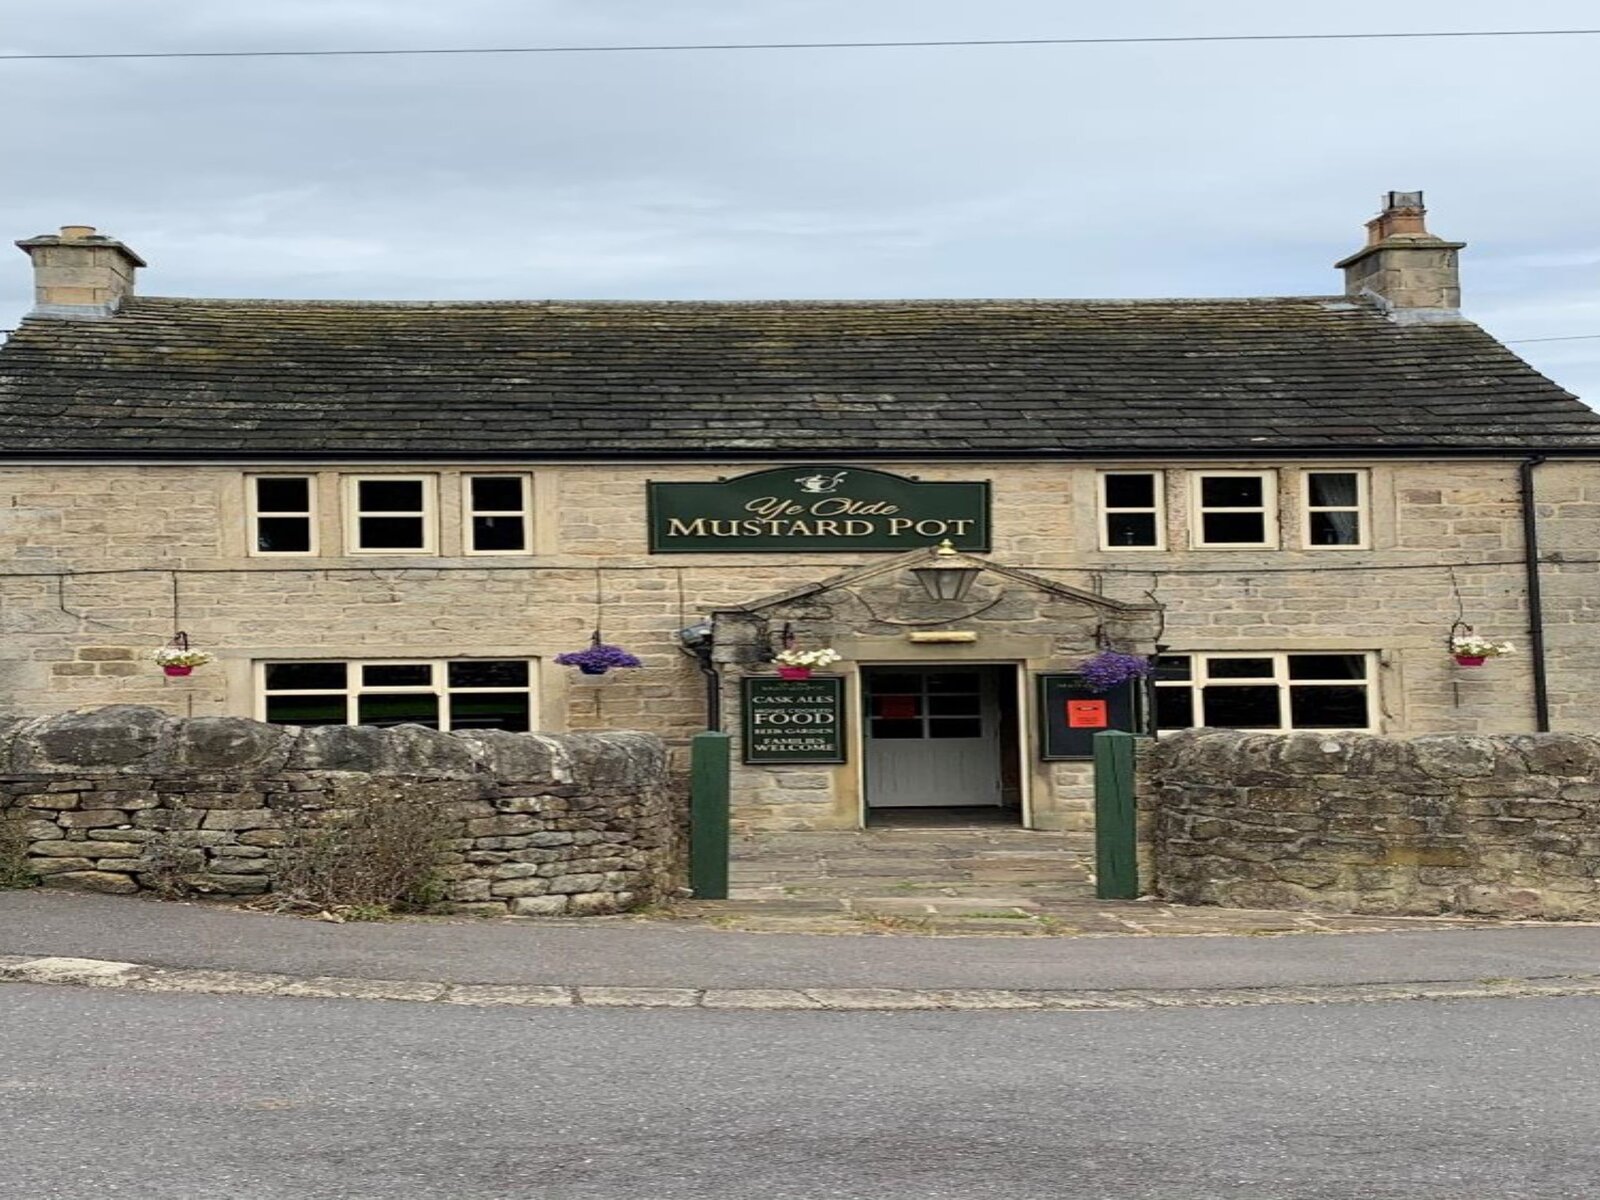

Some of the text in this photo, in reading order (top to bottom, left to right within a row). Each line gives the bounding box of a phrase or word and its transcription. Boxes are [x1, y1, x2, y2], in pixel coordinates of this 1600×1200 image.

[745, 496, 899, 524] Ye Olde
[666, 517, 974, 537] MUSTARD POT
[752, 695, 834, 704] CASK ALES
[754, 713, 834, 725] FOOD
[754, 744, 836, 752] WELCOME
